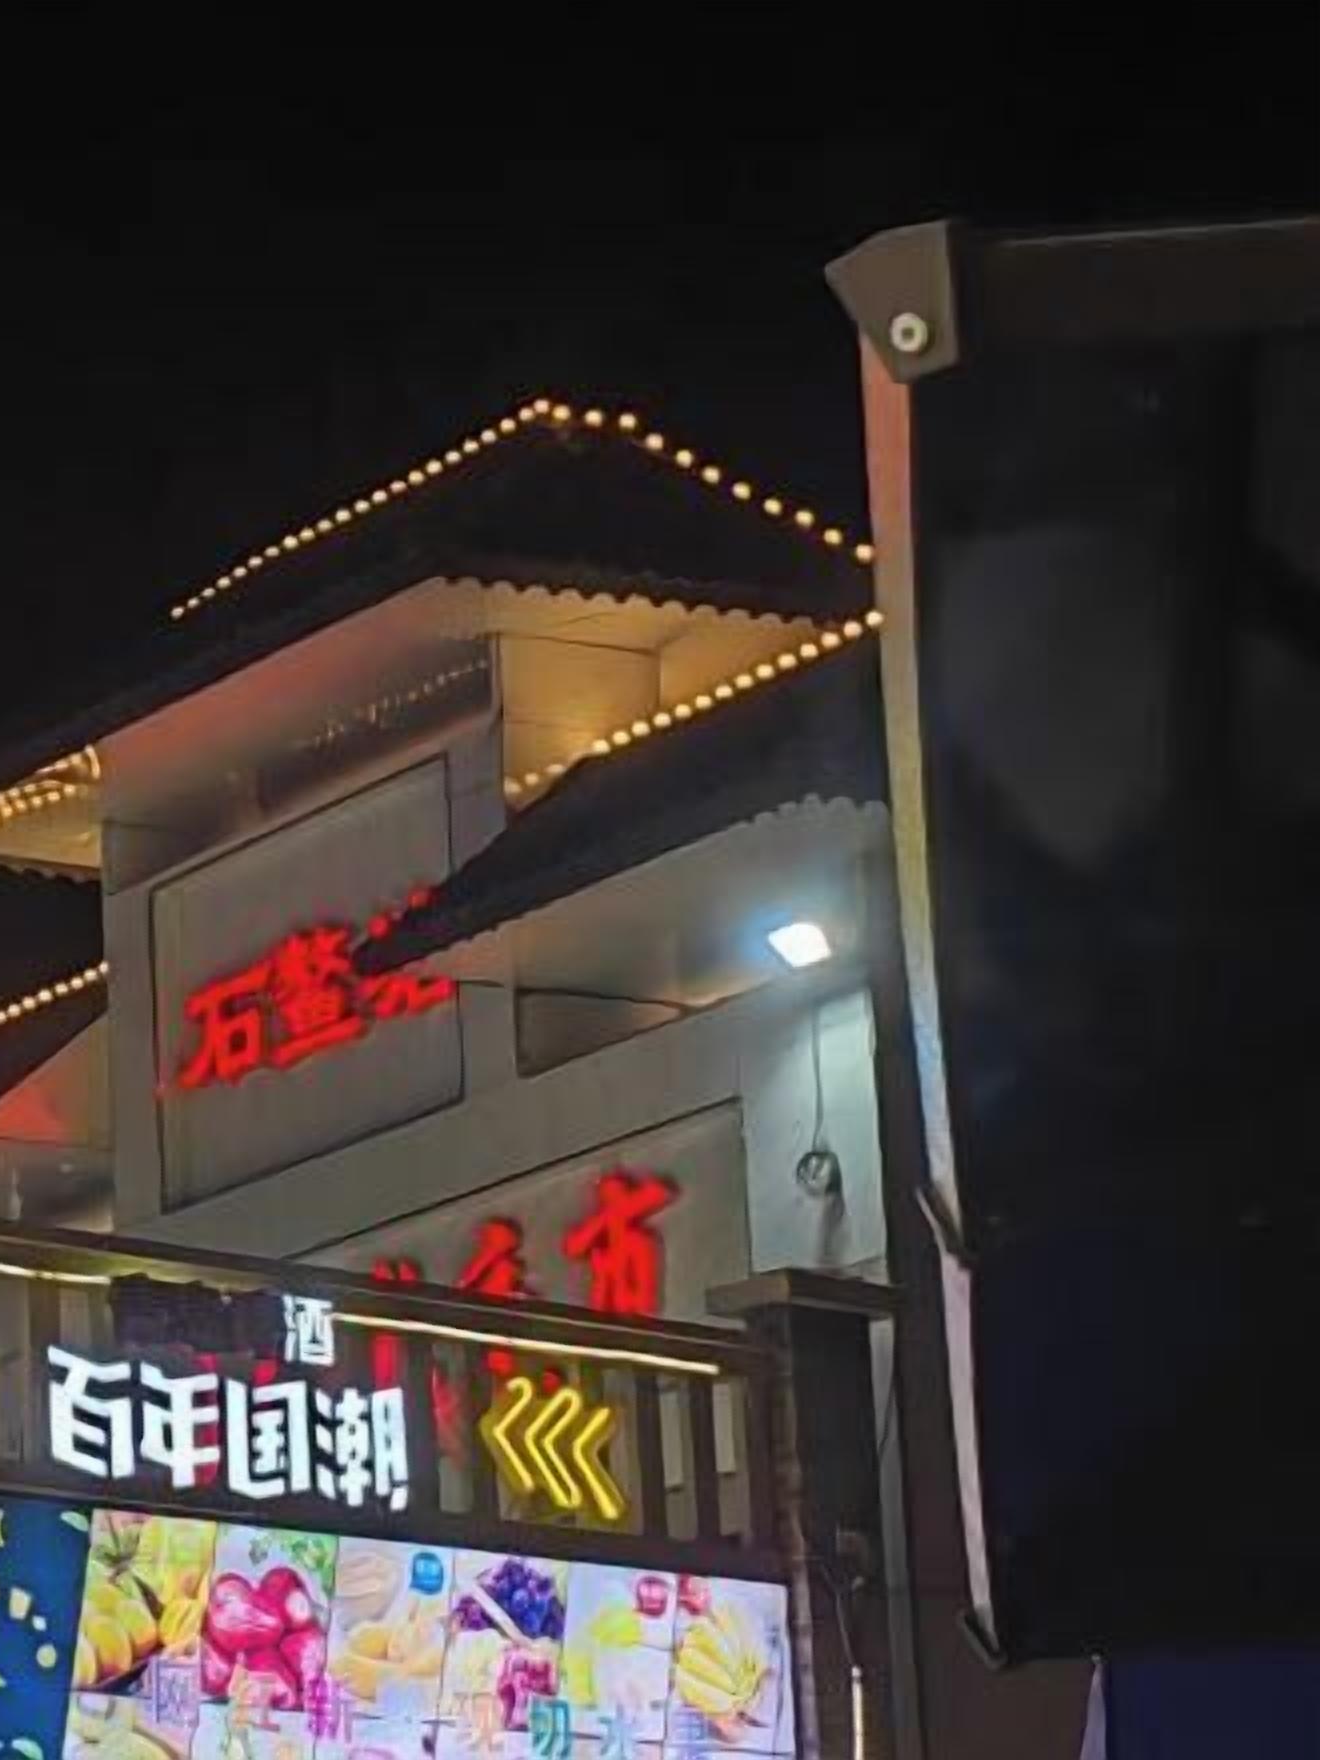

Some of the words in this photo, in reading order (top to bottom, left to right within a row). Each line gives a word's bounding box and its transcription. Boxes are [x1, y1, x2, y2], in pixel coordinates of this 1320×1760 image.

[283, 1295, 334, 1366] 酒
[47, 1344, 408, 1511] 百年国潮
